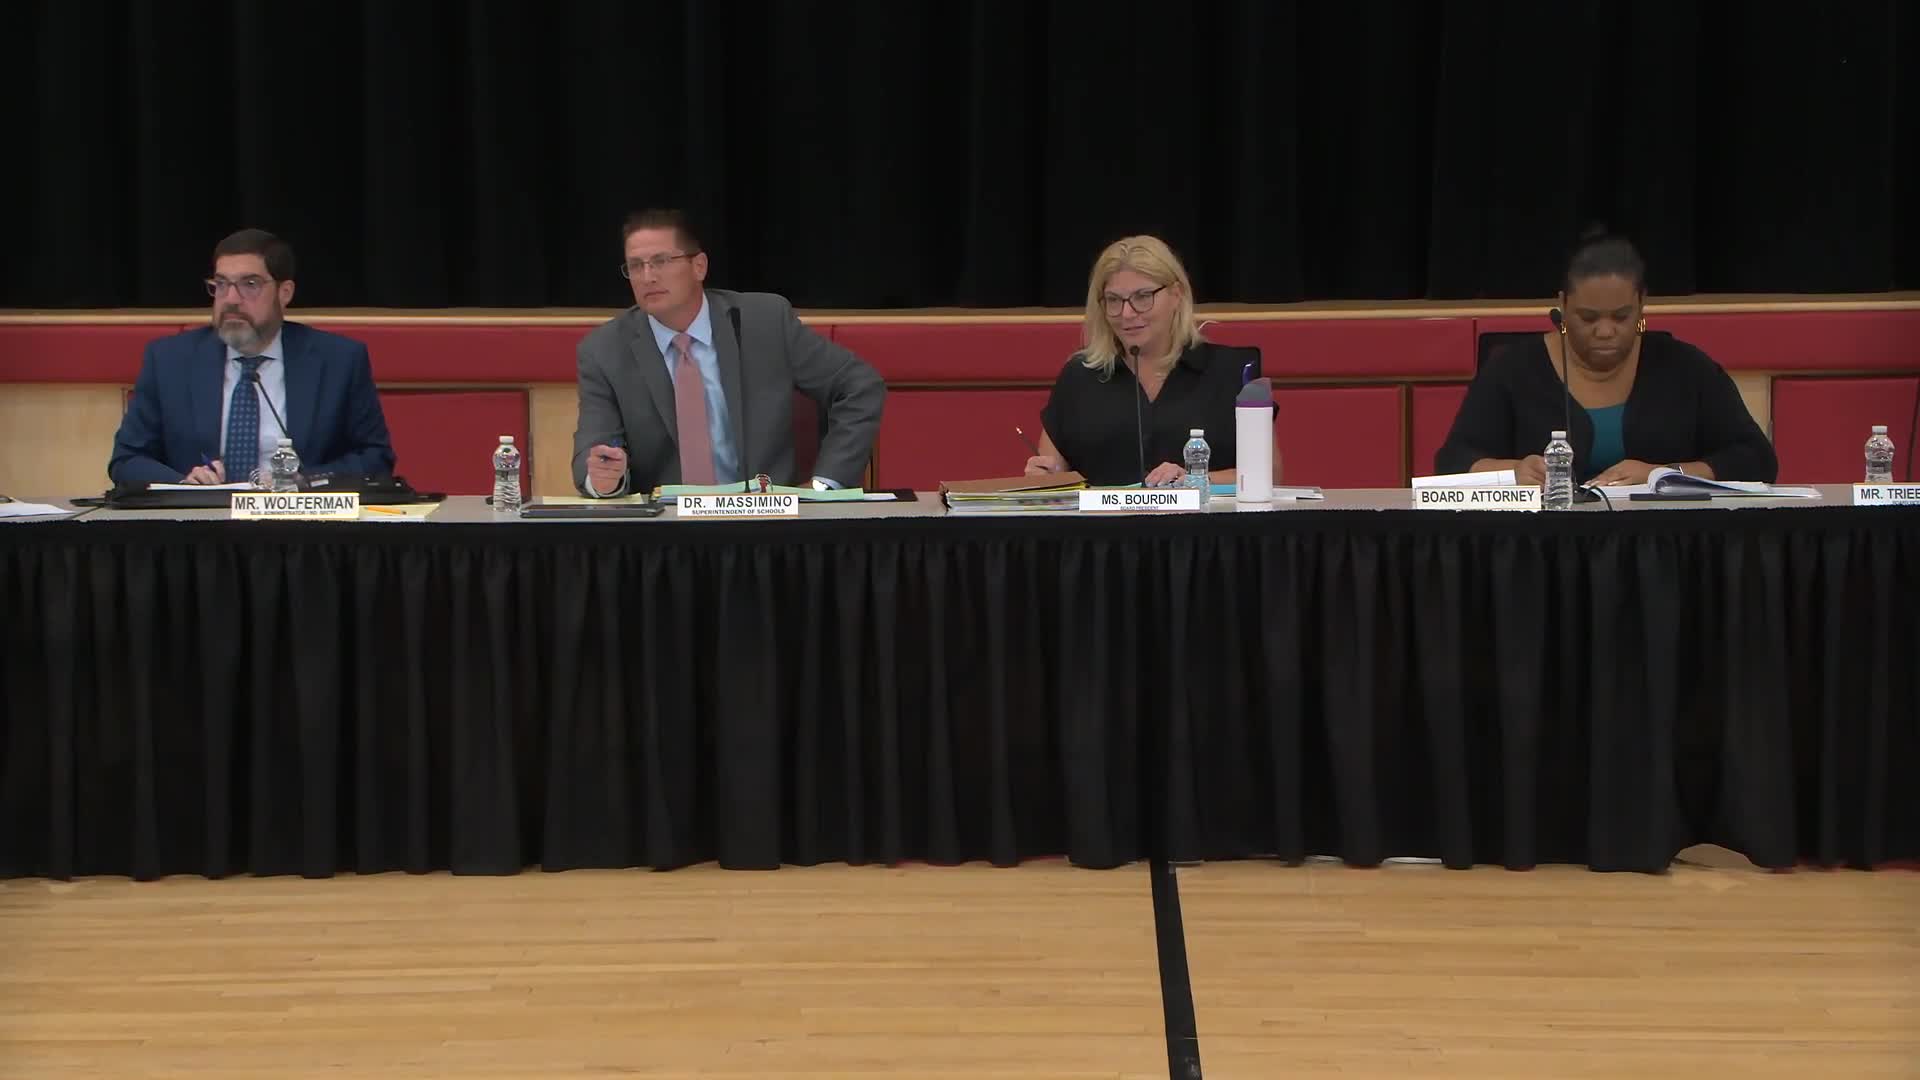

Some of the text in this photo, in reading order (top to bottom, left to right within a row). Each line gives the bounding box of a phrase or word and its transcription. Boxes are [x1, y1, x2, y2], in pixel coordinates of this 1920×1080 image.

[1101, 494, 1178, 505] MS. BOURDIN
[1421, 490, 1535, 503] BOARD ATTORNEY
[1860, 488, 1884, 499] MR.
[235, 496, 354, 510] MR. WOLFERMAN
[684, 496, 792, 508] DR. MASSIMINO
